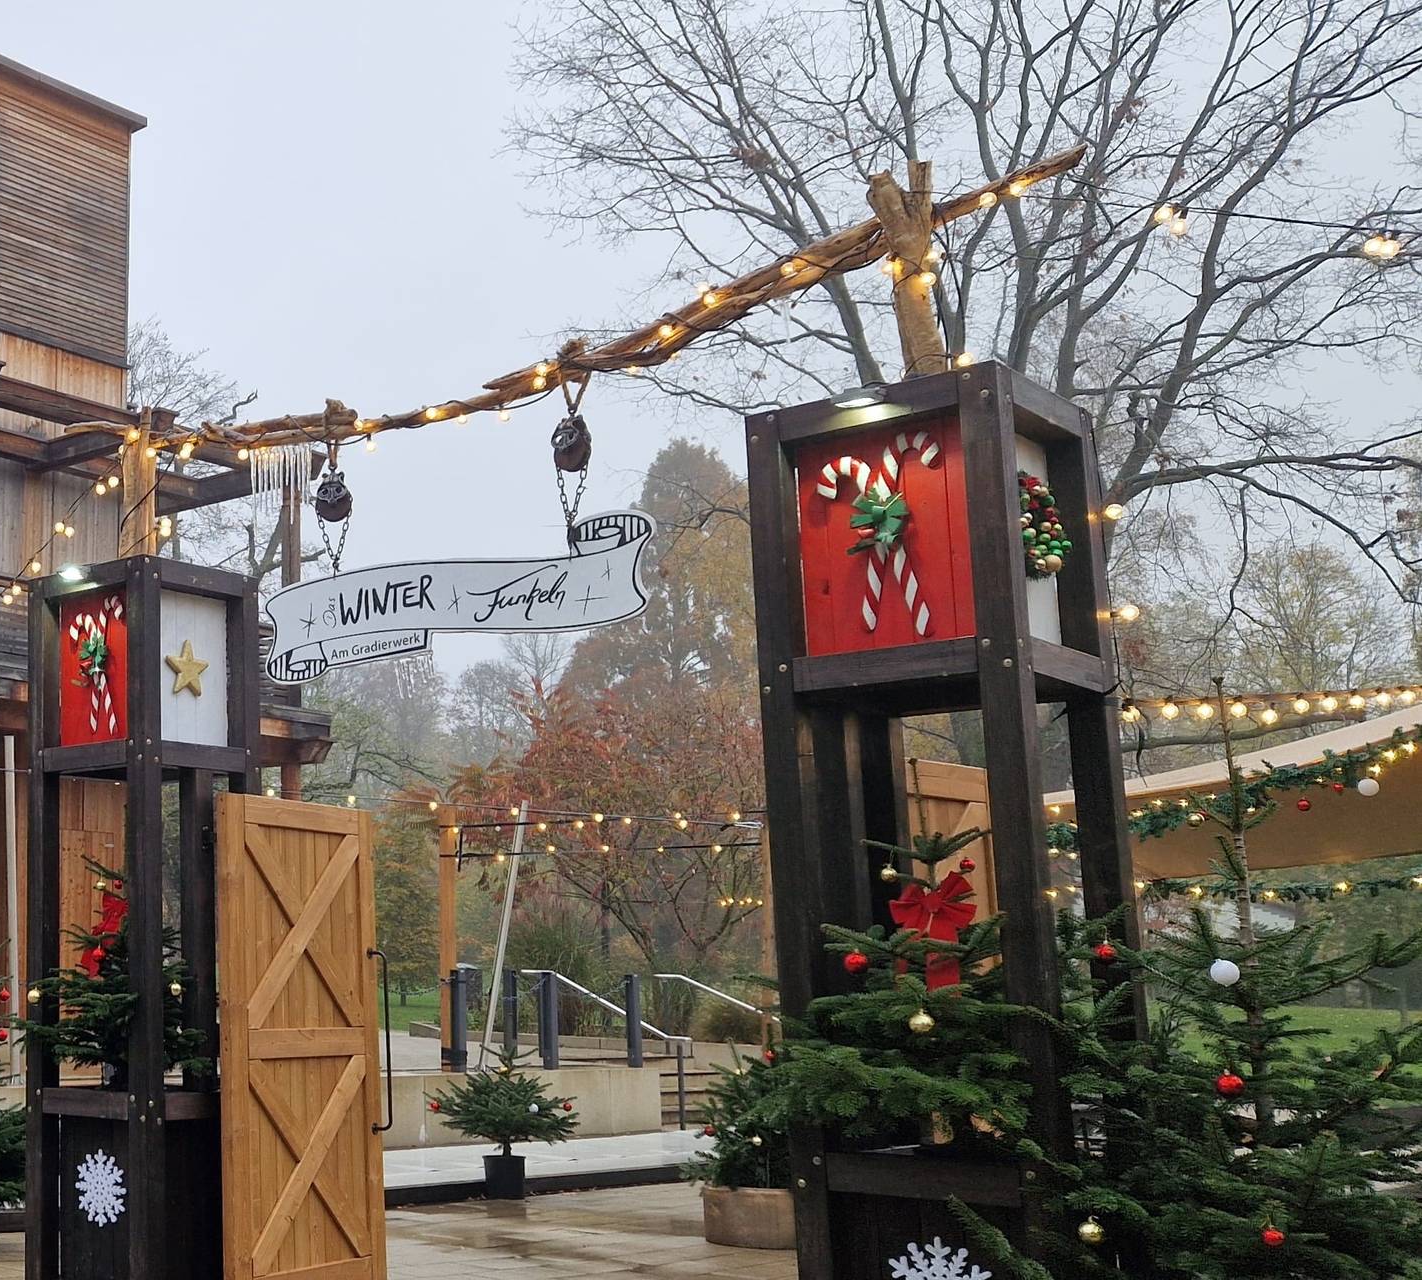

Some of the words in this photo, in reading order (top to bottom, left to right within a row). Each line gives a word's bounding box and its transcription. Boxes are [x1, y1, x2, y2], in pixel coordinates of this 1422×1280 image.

[323, 597, 336, 628] Das
[339, 574, 436, 626] WINTER
[466, 564, 568, 622] Funkeln
[331, 649, 349, 660] Am
[351, 632, 420, 656] Gradierwerk
